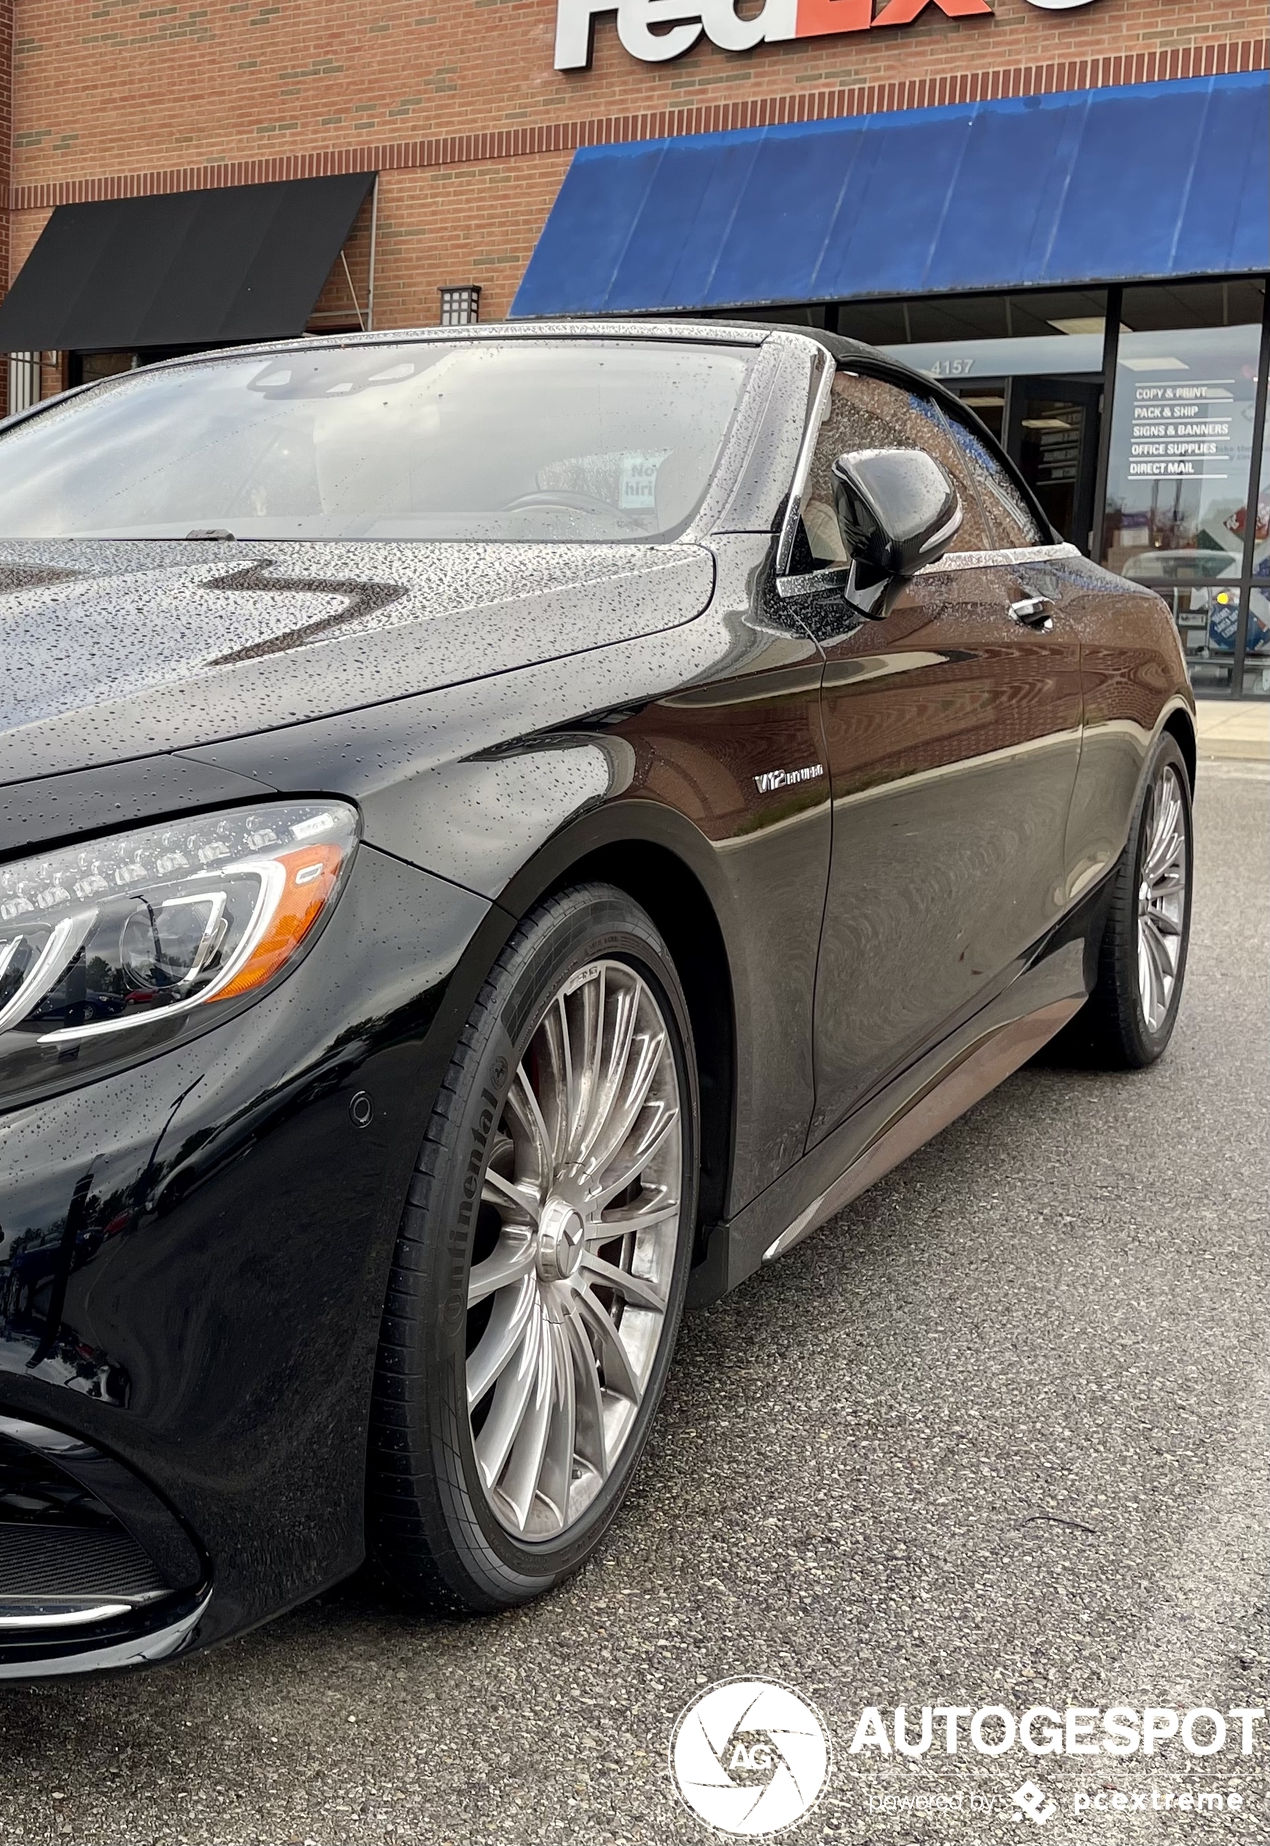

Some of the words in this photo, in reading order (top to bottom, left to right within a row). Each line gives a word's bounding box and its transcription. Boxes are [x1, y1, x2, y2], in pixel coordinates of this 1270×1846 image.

[931, 359, 974, 375] 4157
[1136, 388, 1164, 399] COPY
[1165, 388, 1173, 398] &
[1176, 387, 1207, 398] PRINT
[1134, 407, 1160, 418] PACK
[1162, 407, 1171, 417] &
[1174, 406, 1199, 417] SHIP
[1133, 425, 1165, 437] SIGNS
[1167, 425, 1175, 436] &
[1177, 424, 1229, 435] BANNERS
[1131, 444, 1165, 455] OFFICE
[1167, 443, 1217, 454] SUPPLIES
[1130, 463, 1166, 474] DIRECT
[1167, 462, 1194, 474] MAIL
[752, 769, 786, 794] V12
